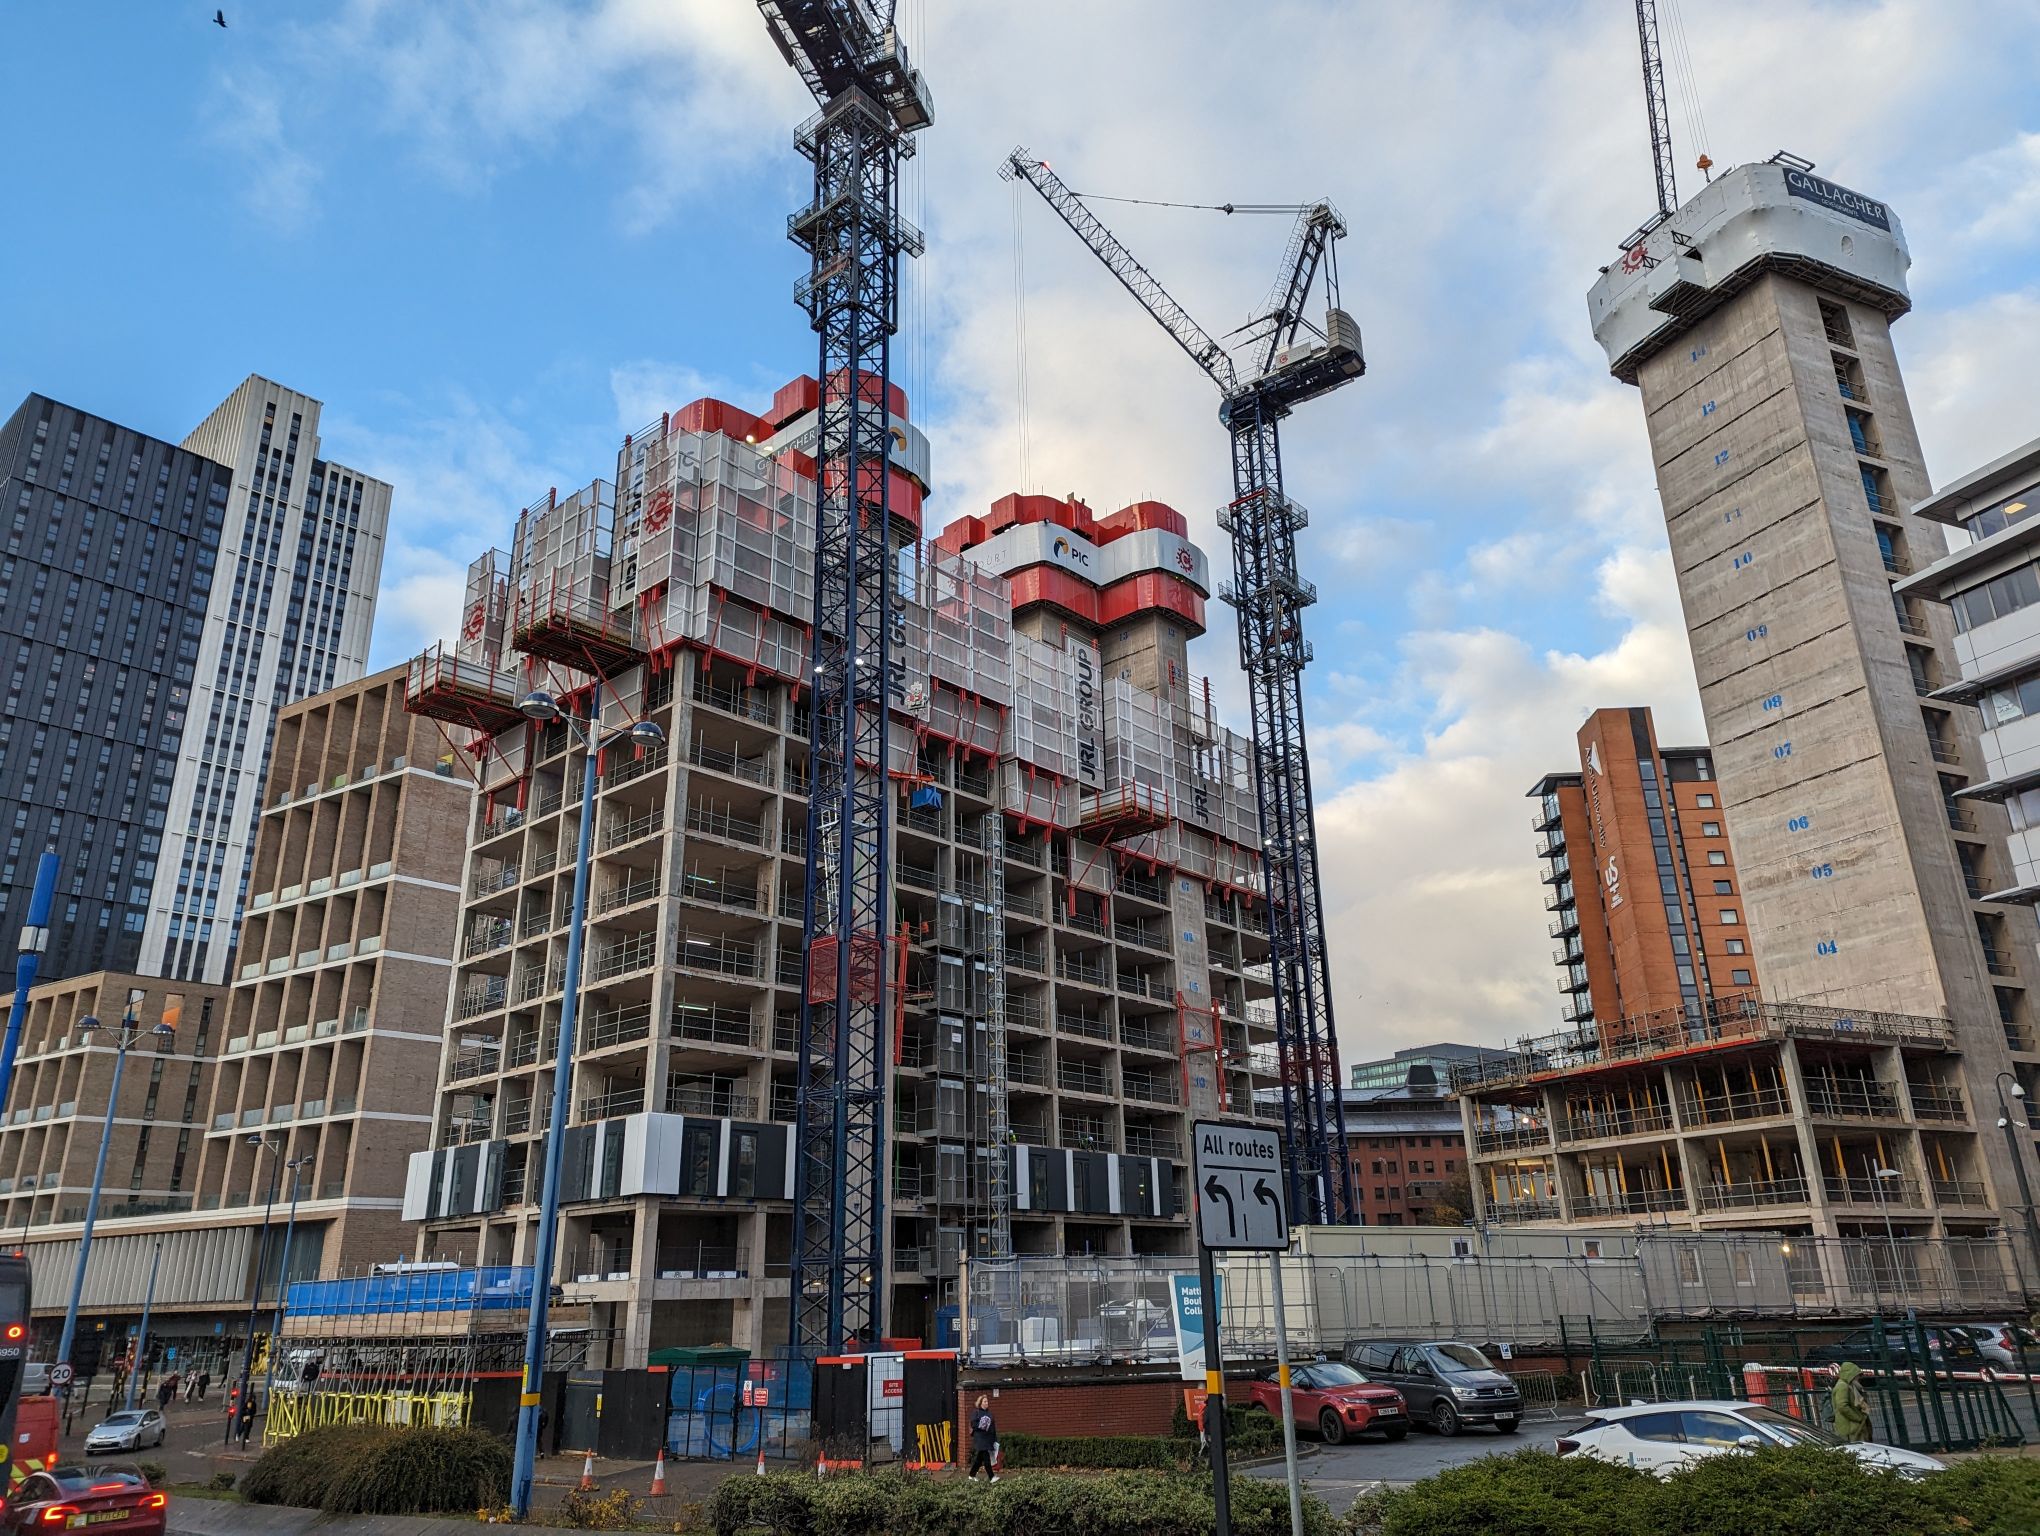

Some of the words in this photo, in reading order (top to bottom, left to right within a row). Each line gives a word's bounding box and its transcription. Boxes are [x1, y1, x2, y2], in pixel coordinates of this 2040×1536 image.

[1788, 172, 1885, 220] GALLAGHER
[1652, 196, 1702, 243] COURT
[1702, 401, 1717, 417] 13
[1714, 451, 1730, 466] 12
[1072, 548, 1089, 567] PIC
[1733, 552, 1752, 570] 10
[1747, 624, 1768, 641] 09
[888, 656, 906, 705] JRL
[1078, 648, 1095, 732] GROUP
[1763, 695, 1783, 711] 08
[1774, 740, 1792, 759] 07
[1081, 737, 1095, 781] JRL
[1194, 783, 1209, 824] JRL
[1788, 816, 1809, 832] 06
[1812, 864, 1833, 880] 05
[1817, 940, 1838, 955] 04
[1203, 1134, 1224, 1155] All
[1228, 1139, 1274, 1159] routes
[1183, 1296, 1202, 1305] Boul
[53, 1369, 71, 1379] 20
